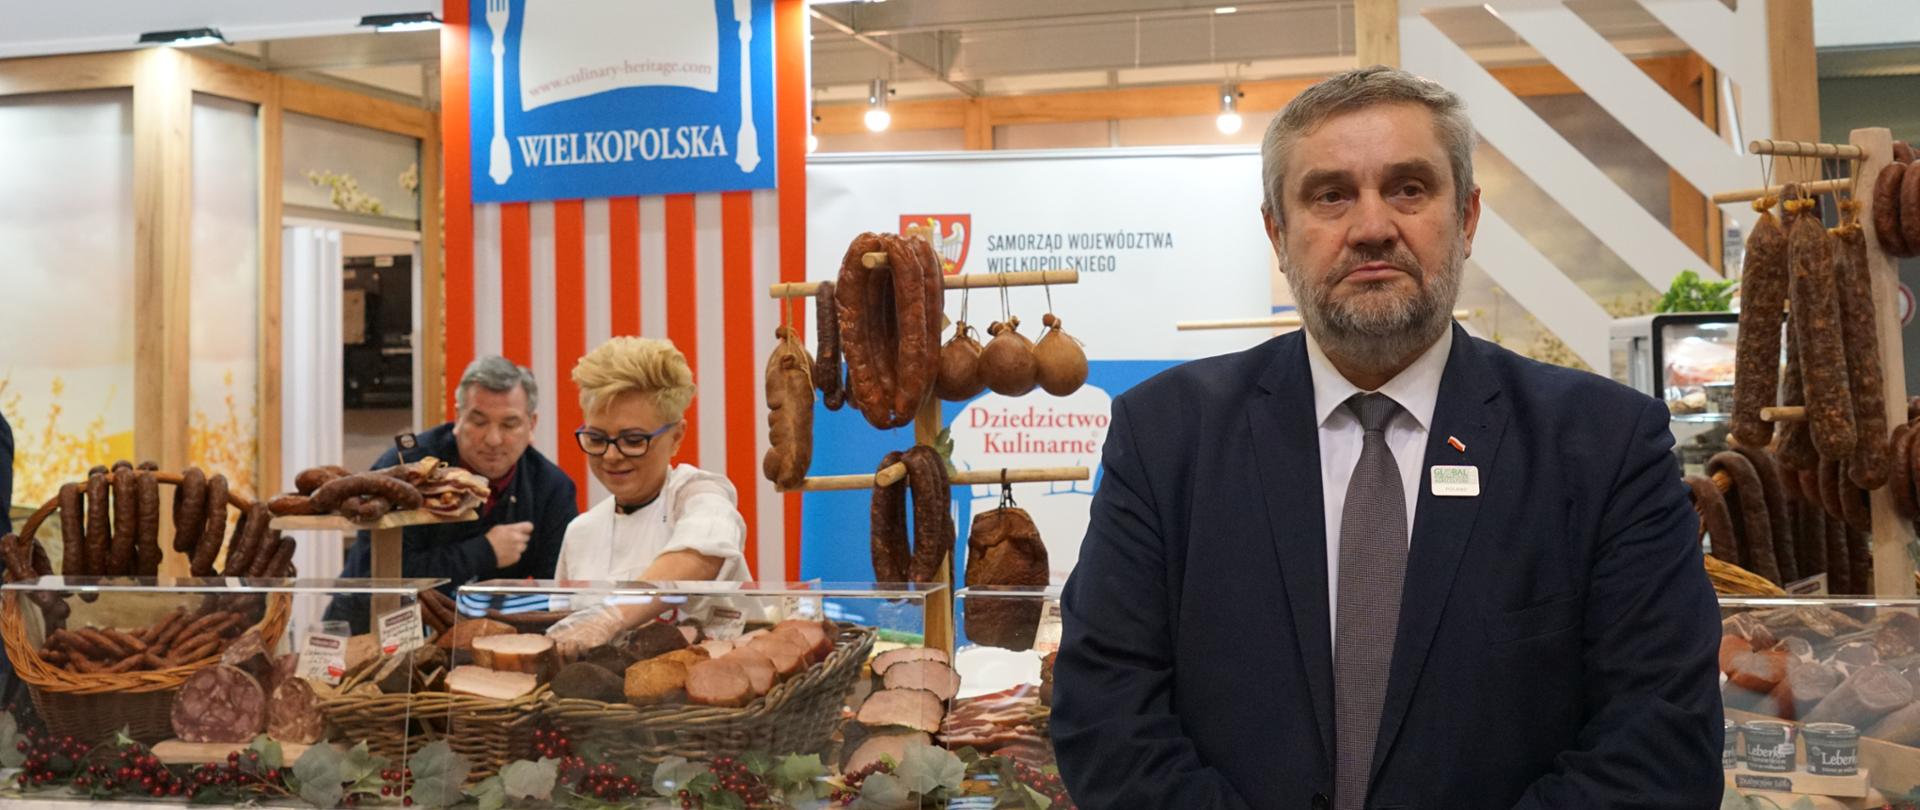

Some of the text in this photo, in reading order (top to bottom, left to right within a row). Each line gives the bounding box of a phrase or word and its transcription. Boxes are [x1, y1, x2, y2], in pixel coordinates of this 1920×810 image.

[529, 60, 712, 97] www.culinary-heritage.com
[517, 125, 729, 168] WIELKOPOLSKA
[987, 229, 1174, 253] SAMORZĄD WOJEWÓDZTWA
[987, 255, 1116, 273] WIELKOPOLSKIEGO
[969, 406, 1109, 428] Dziedzictwo
[983, 431, 1096, 453] Kulinarne
